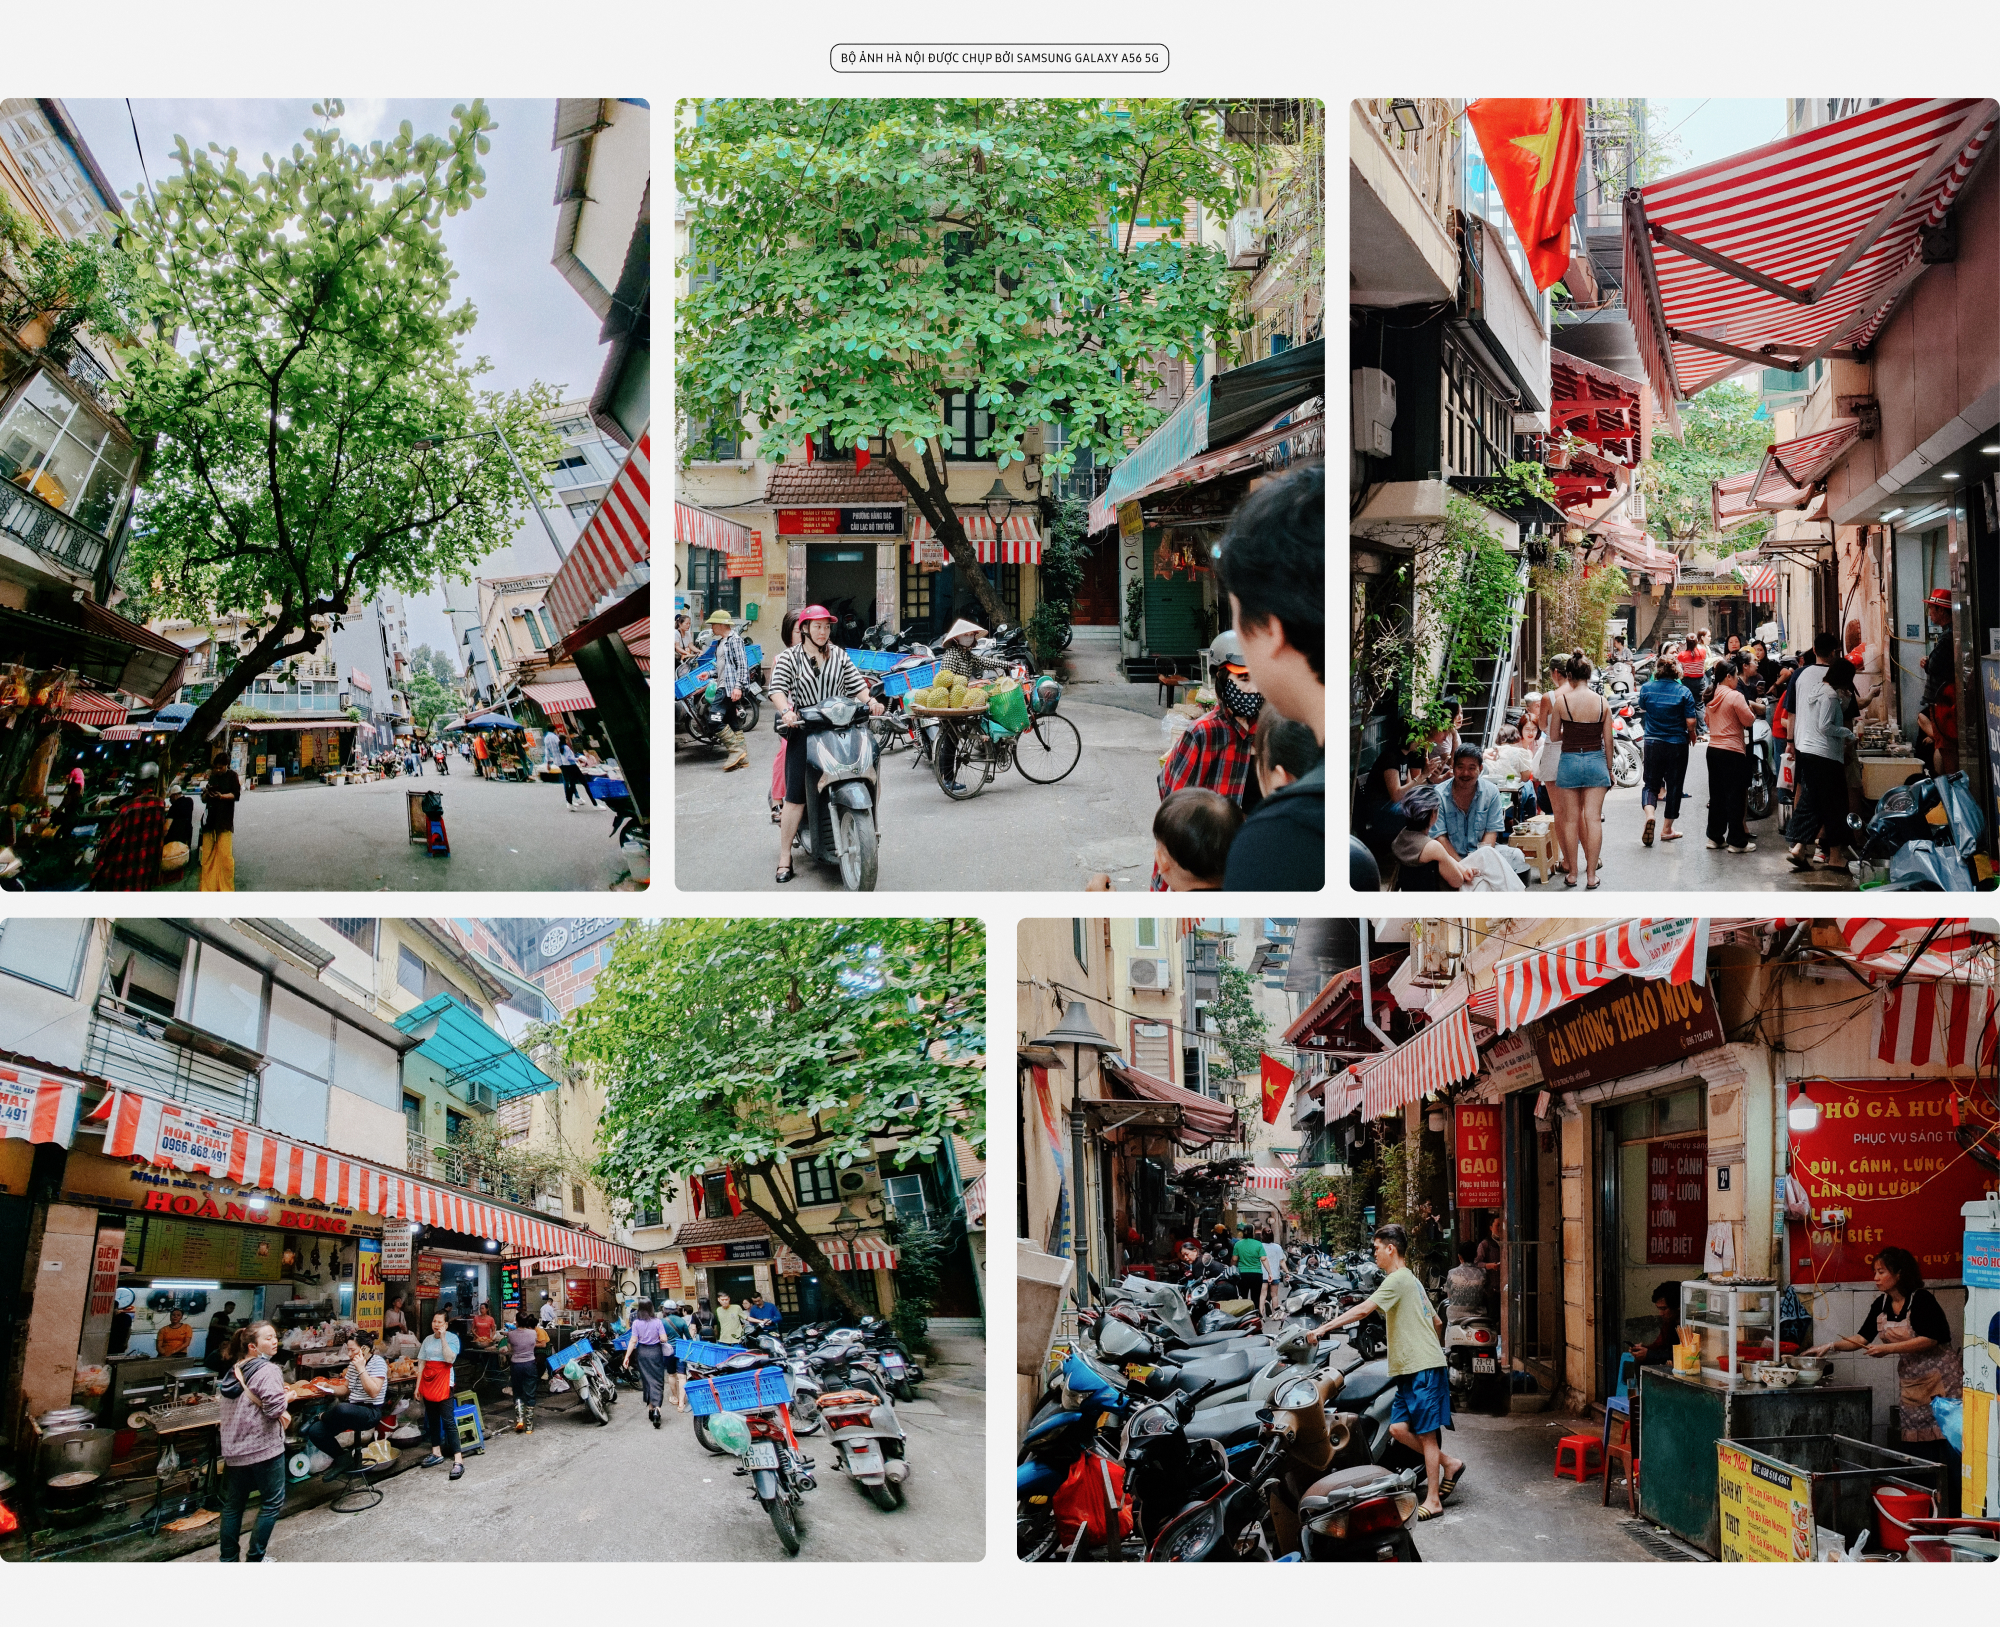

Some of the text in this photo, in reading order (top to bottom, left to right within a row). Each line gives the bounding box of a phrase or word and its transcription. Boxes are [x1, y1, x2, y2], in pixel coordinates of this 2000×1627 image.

[1549, 1018, 1571, 1067] GÀ
[1564, 1004, 1614, 1060] NƯỚNG
[1611, 974, 1659, 1042] THẢO
[1866, 1096, 1902, 1118] GÀ
[1462, 1111, 1494, 1130] ĐẠI
[163, 1125, 192, 1142] HÒA
[1468, 1132, 1489, 1151] LÝ
[1853, 1128, 1943, 1145] PHỤC VỤ SÁNG
[161, 1136, 227, 1164] 0966.868.491
[1663, 1140, 1691, 1151] Phục vụ
[1460, 1158, 1498, 1177] GẠO
[1651, 1154, 1703, 1175] ĐÙI CÁNH
[1810, 1156, 1945, 1175] ĐÙI, CÁNH, LƯNG
[131, 1170, 169, 1186] Nhận
[1846, 1179, 1874, 1197] ĐÙI
[1878, 1178, 1920, 1196] LƯỜN
[1651, 1179, 1701, 1201] ĐÙI LƯỜN
[144, 1190, 269, 1224] HOÀNG
[1651, 1207, 1677, 1228] LƯỜN
[1651, 1233, 1693, 1258] ĐẶC BIỆT
[1847, 1226, 1884, 1246] BIỆT
[97, 1245, 119, 1260] ĐIỂM
[97, 1259, 115, 1272] BÁN
[93, 1273, 117, 1293] CHIM
[91, 1295, 114, 1316] QUAY
[1719, 1446, 1748, 1473] Hoa Mai
